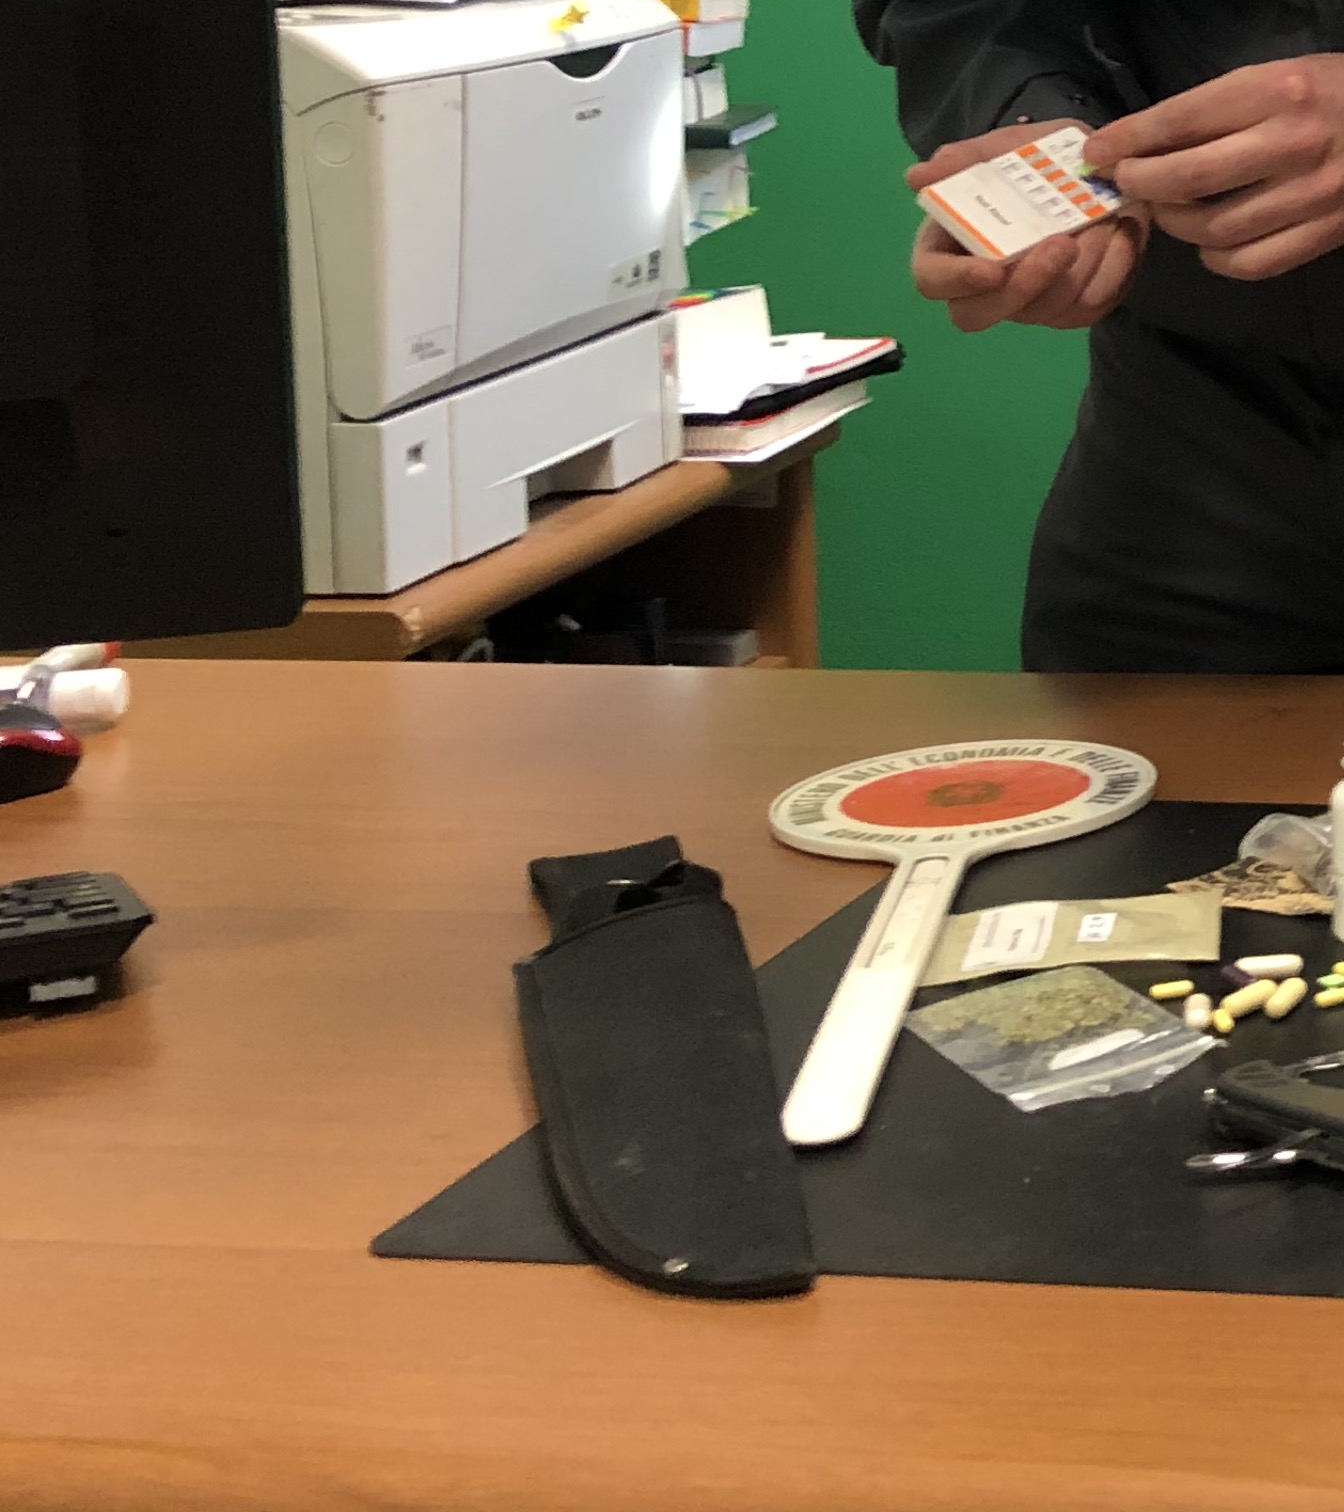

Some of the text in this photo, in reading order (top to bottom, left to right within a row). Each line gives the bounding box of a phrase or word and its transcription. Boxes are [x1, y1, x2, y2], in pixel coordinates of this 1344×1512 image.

[908, 746, 1046, 767] ECONOMIA
[823, 828, 918, 843] GUARDIA
[969, 815, 1072, 839] FINANZA
